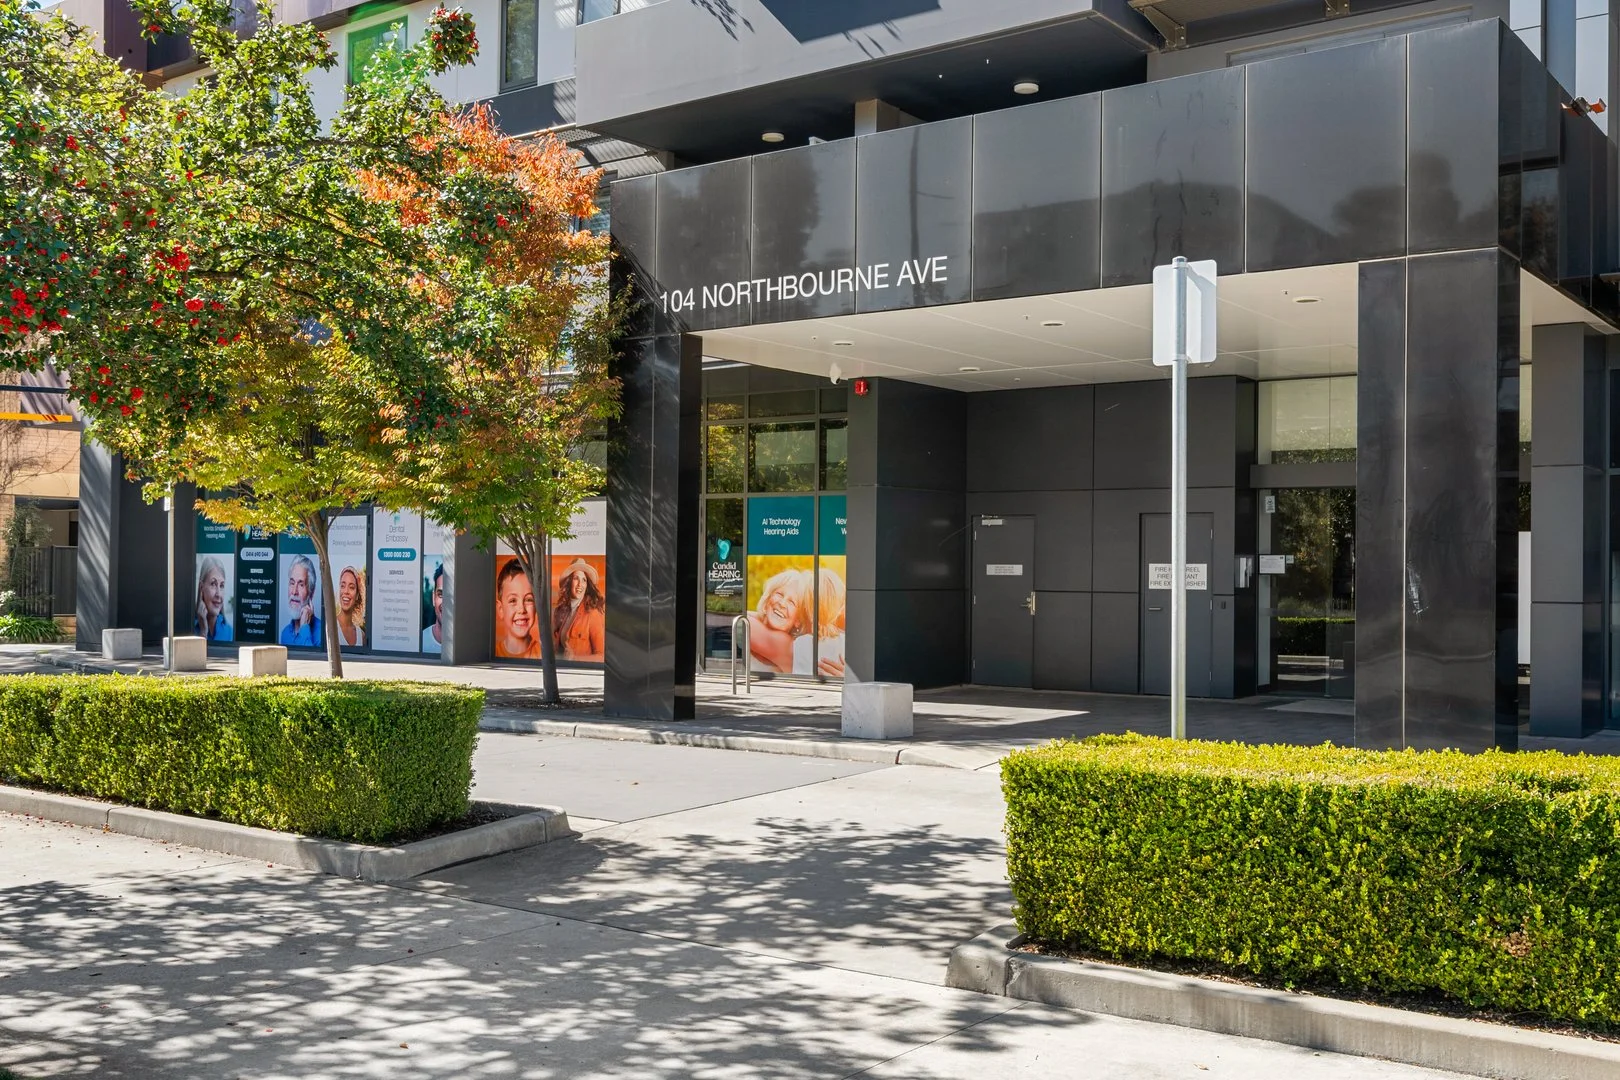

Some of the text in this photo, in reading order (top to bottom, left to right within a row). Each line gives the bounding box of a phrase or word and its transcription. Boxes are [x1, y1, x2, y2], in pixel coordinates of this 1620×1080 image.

[660, 255, 948, 313] 104 NORTHBOURNE AVE
[769, 518, 801, 526] Technology
[388, 524, 404, 533] Dental
[763, 528, 800, 536] Hearing Aids
[386, 534, 408, 543] Embassy
[713, 562, 736, 570] Candid
[709, 570, 740, 578] HEARING
